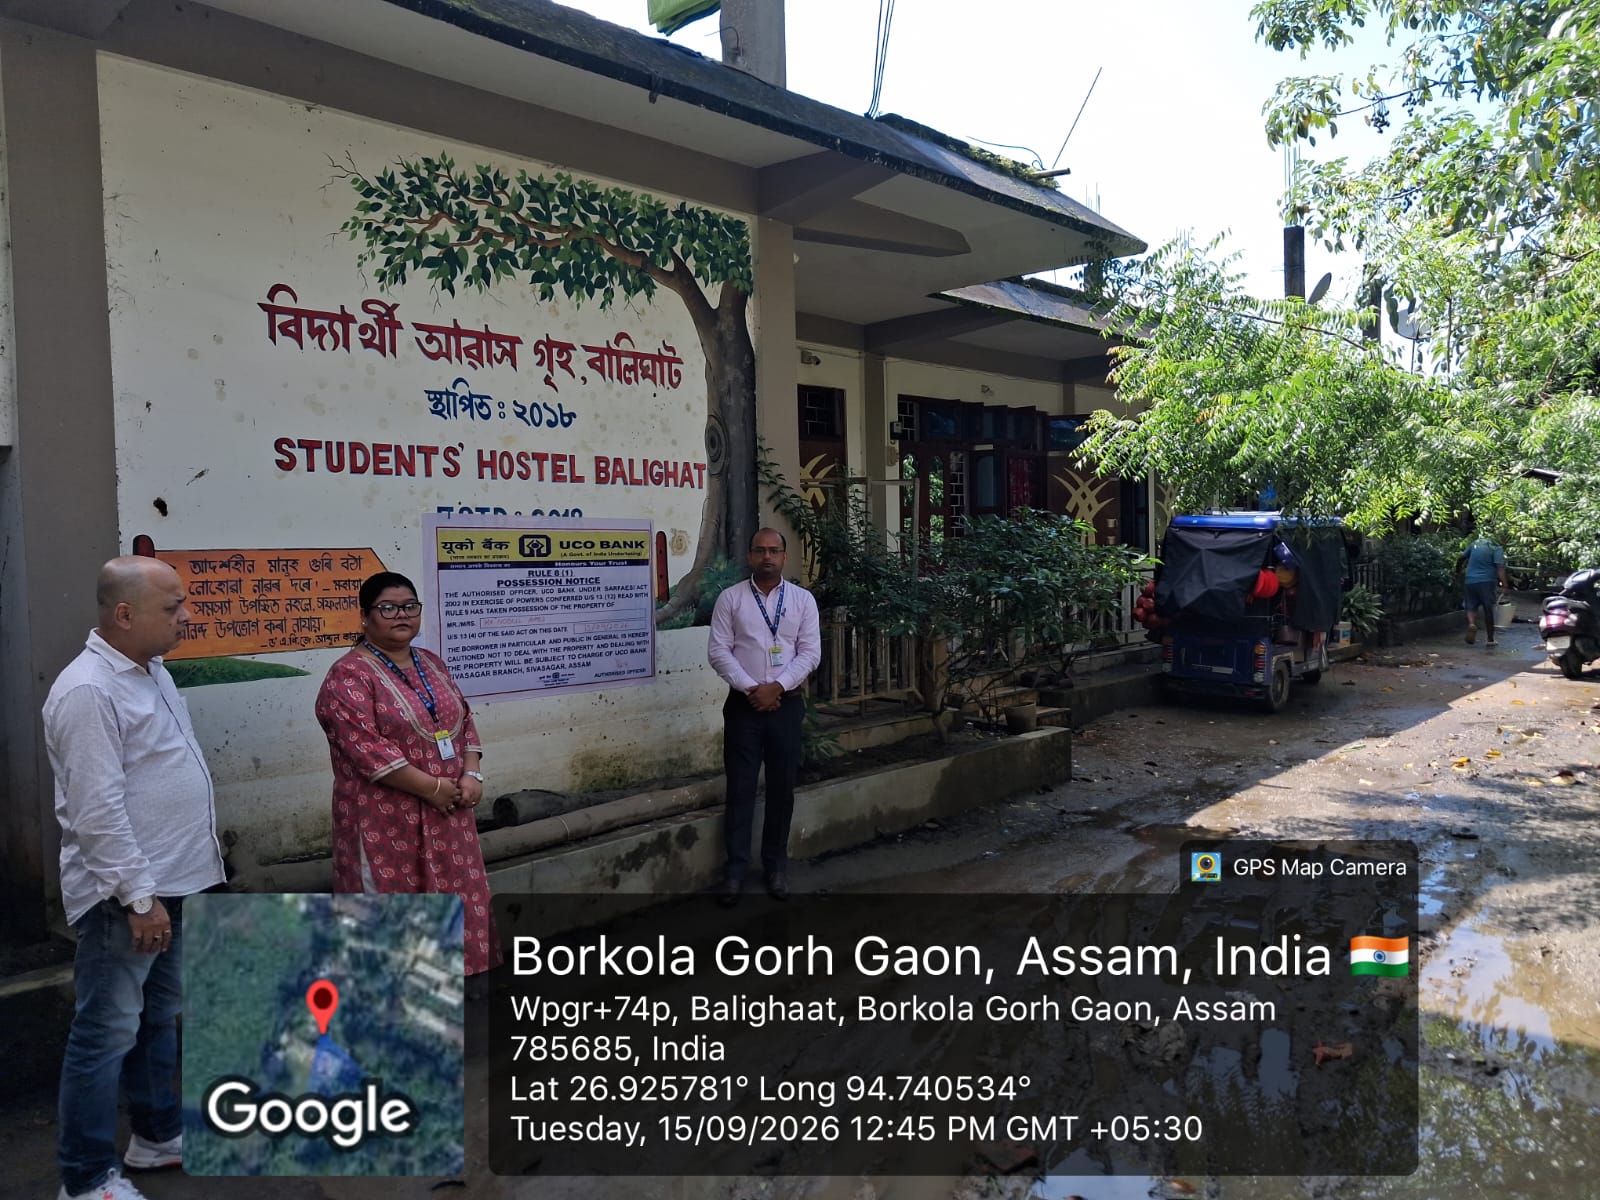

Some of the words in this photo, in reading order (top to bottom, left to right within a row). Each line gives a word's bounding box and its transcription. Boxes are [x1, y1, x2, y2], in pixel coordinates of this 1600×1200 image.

[581, 332, 684, 389] বালিঘাট
[424, 377, 493, 421] স্থাপিত
[513, 400, 577, 428] ২০১৮
[477, 449, 585, 483] HOSTEL
[594, 456, 706, 489] BALIGHAT
[441, 538, 475, 554] यूको
[559, 541, 595, 550] UCO
[600, 541, 645, 549] BANK
[562, 569, 573, 577] (1)
[497, 578, 562, 588] POSSESSION
[566, 577, 600, 585] NOTICE
[462, 590, 505, 598] AUTHORISED
[509, 605, 548, 613] POSSESSION
[462, 644, 498, 652] BORROWER
[508, 640, 546, 648] PARTICULAR
[448, 653, 485, 662] CAUTIONED
[563, 644, 594, 652] PROPERTY
[463, 661, 502, 670] PROPERTY
[535, 655, 565, 663] SUBJECT
[451, 671, 490, 680] IVASAGAR
[493, 668, 524, 676] BRANCH,
